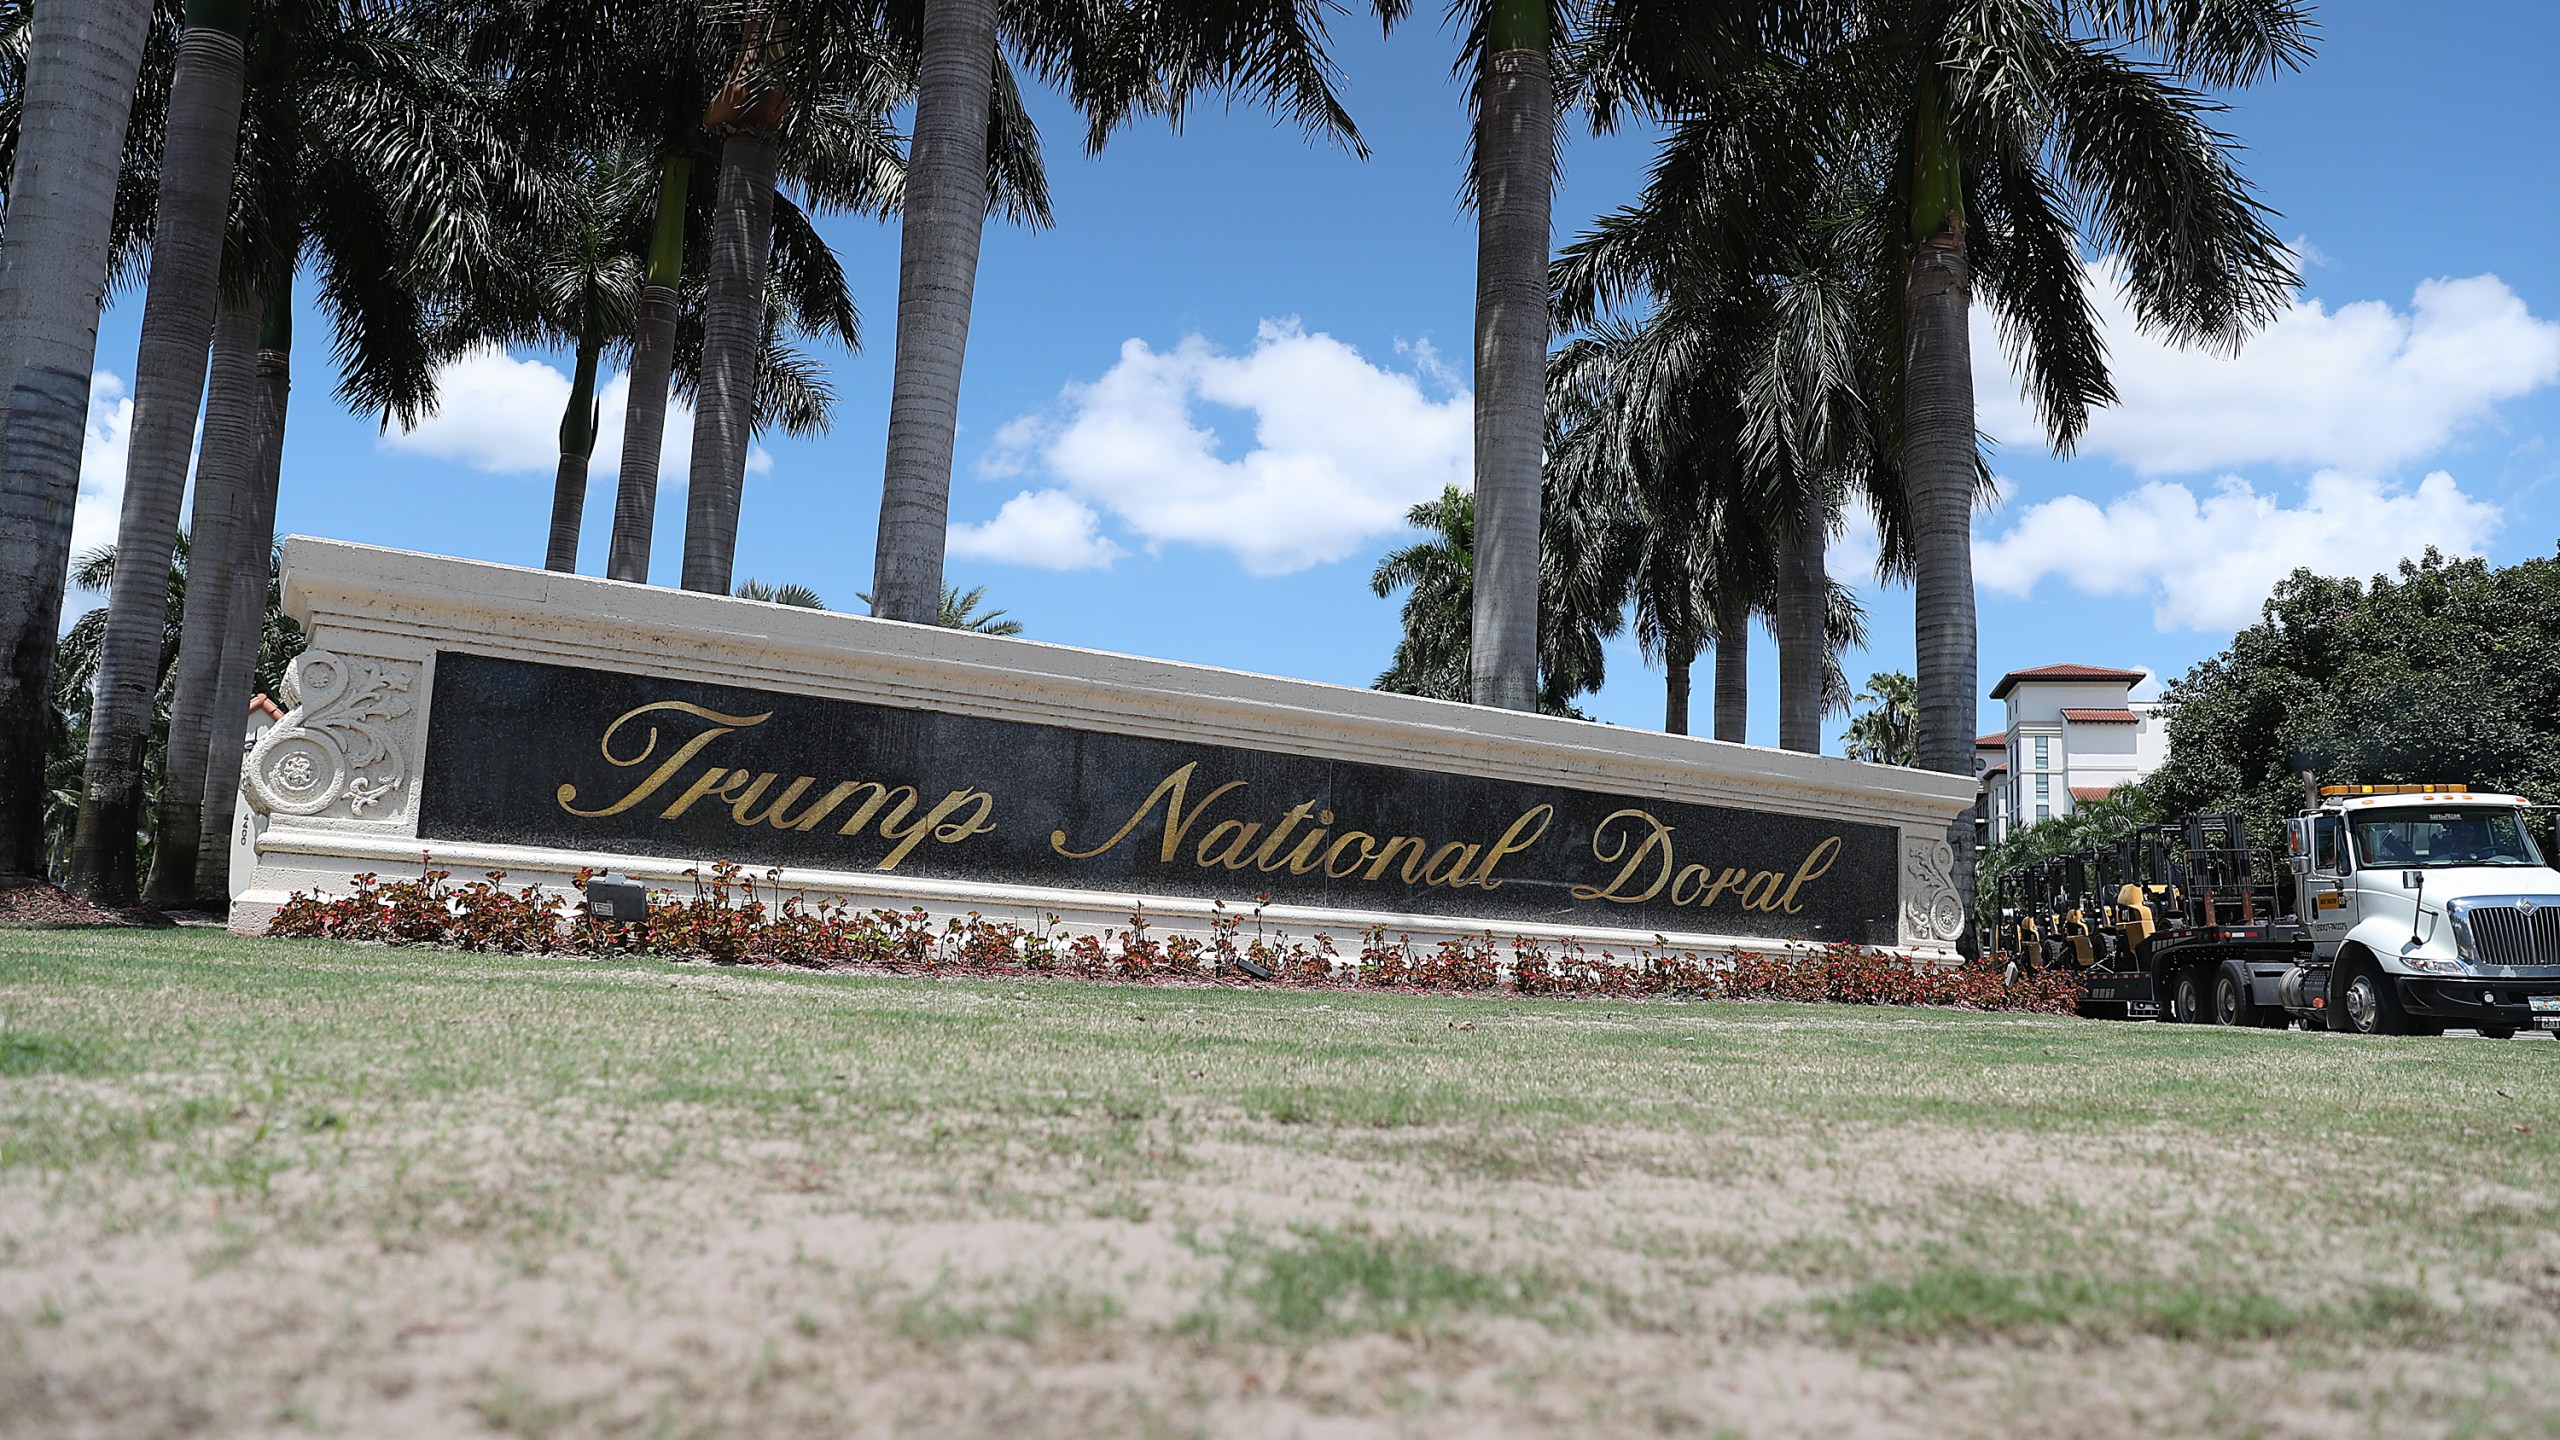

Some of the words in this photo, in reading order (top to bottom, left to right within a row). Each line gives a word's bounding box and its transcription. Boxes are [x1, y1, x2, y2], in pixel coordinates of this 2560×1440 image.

[241, 814, 249, 846] 4400
[557, 700, 997, 870] Trump
[1050, 760, 1554, 891] National
[1571, 809, 1841, 914] Doral
